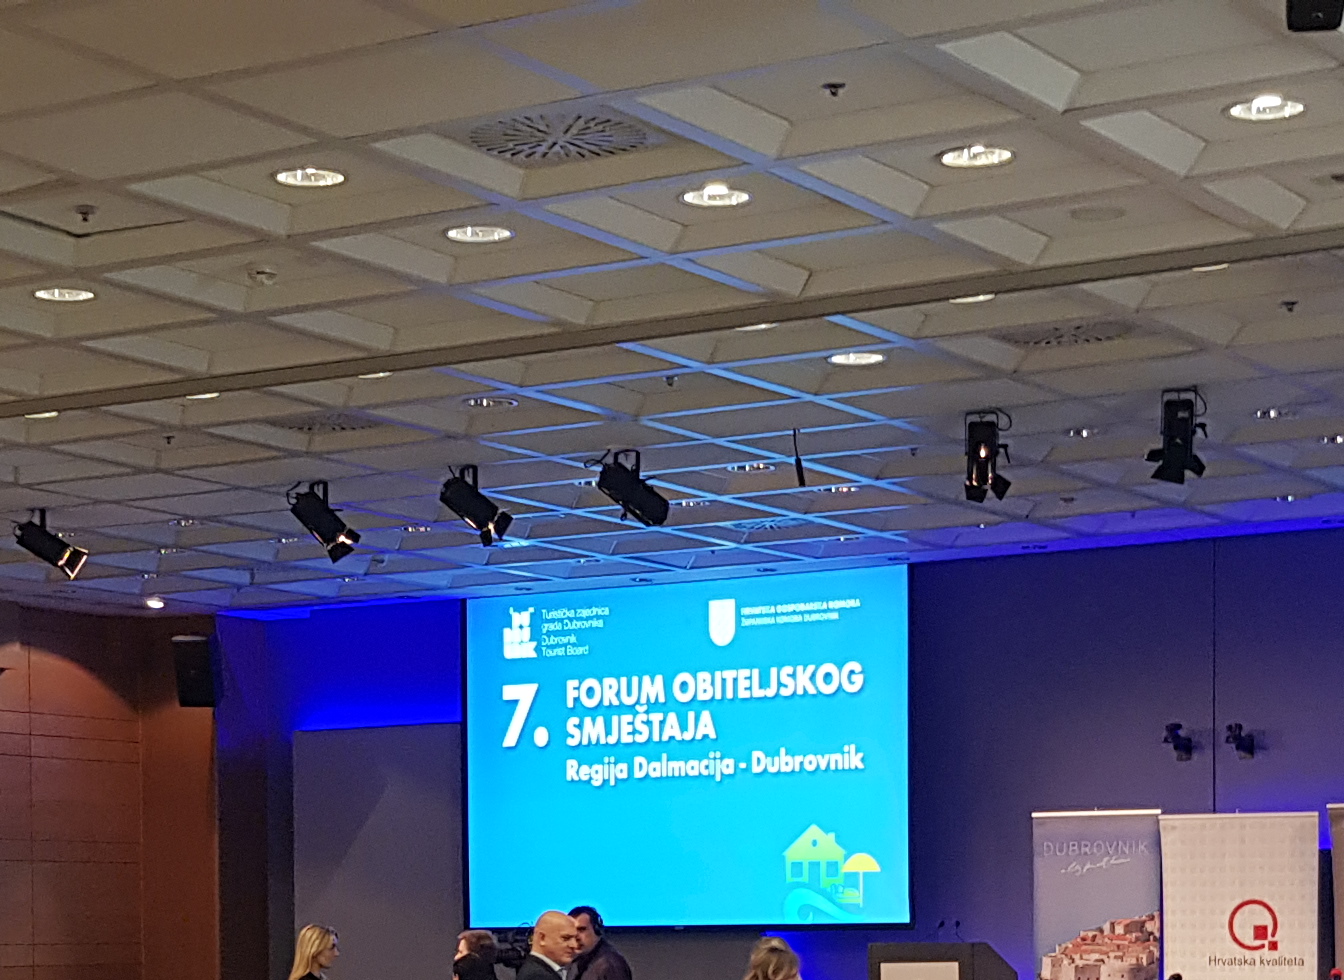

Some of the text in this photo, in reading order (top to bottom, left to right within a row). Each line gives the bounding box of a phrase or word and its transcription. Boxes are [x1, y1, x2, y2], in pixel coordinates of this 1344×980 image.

[566, 660, 865, 709] FORUM OBITELJSKOG
[501, 682, 550, 749] 7.
[566, 705, 717, 747] SMJEŠTAJA
[566, 756, 628, 787] Regija
[633, 752, 736, 783] Dalmacija
[751, 744, 865, 774] Dubrovnik
[1043, 840, 1150, 856] DUBROVNIK
[1208, 955, 1305, 967] Hrvatska kvaliteta
